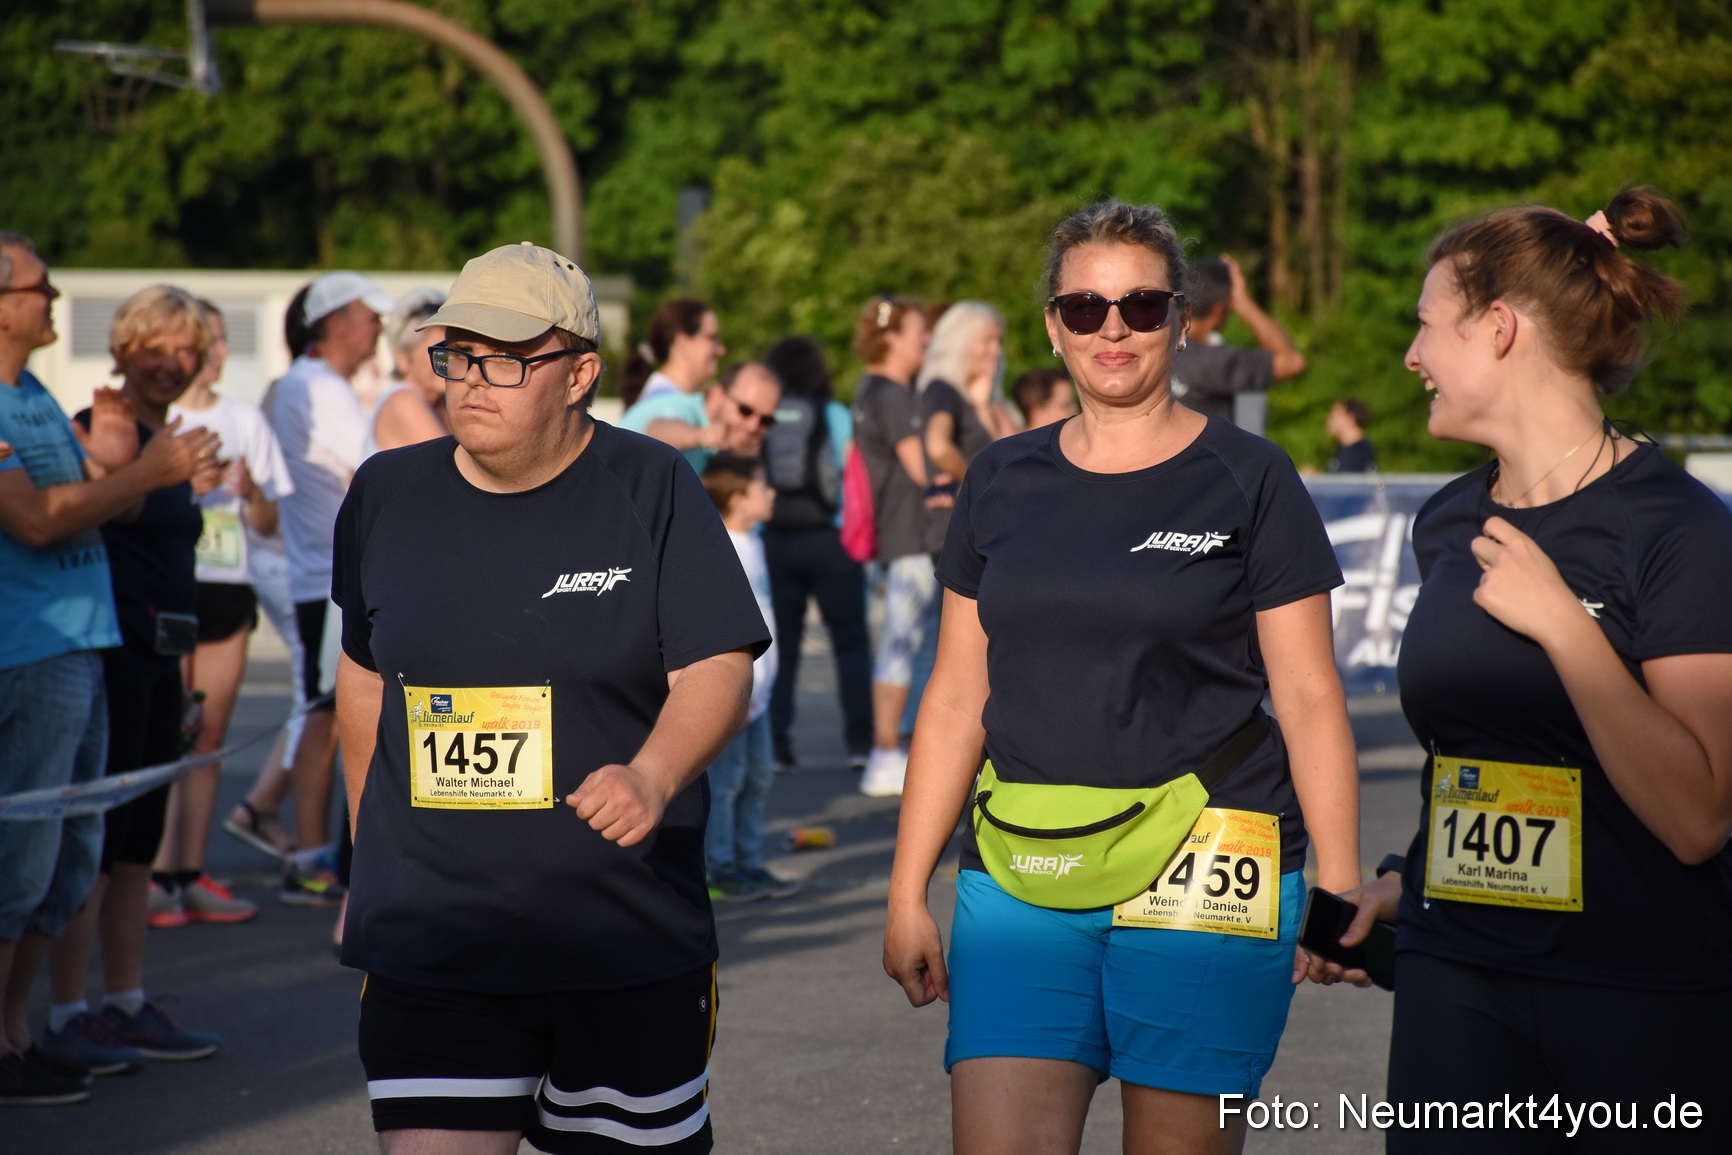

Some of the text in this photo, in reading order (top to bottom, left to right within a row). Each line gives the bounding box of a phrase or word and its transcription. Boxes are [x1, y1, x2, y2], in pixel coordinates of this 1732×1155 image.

[1130, 531, 1204, 553] JURA
[542, 572, 608, 599] JURA
[423, 711, 475, 723] firmenlauf
[482, 717, 541, 730] walk 2019
[423, 731, 529, 775] 1457
[435, 776, 514, 788] Walter Michael
[430, 789, 523, 798] Lebenshilfe Neumarkt e. V
[1450, 785, 1500, 803] firmenlauf
[1506, 800, 1569, 818] walk 2019
[1443, 809, 1556, 867] 1407
[1217, 840, 1273, 858] walk 2019
[1457, 863, 1528, 882] Karl Marina
[1441, 876, 1548, 895] Lebenshilfe Neumarkt e. V
[1149, 895, 1248, 914] Weindl Daniela
[1193, 911, 1235, 923] Neumarkt
[1236, 916, 1244, 924] e.
[1245, 916, 1252, 924] V
